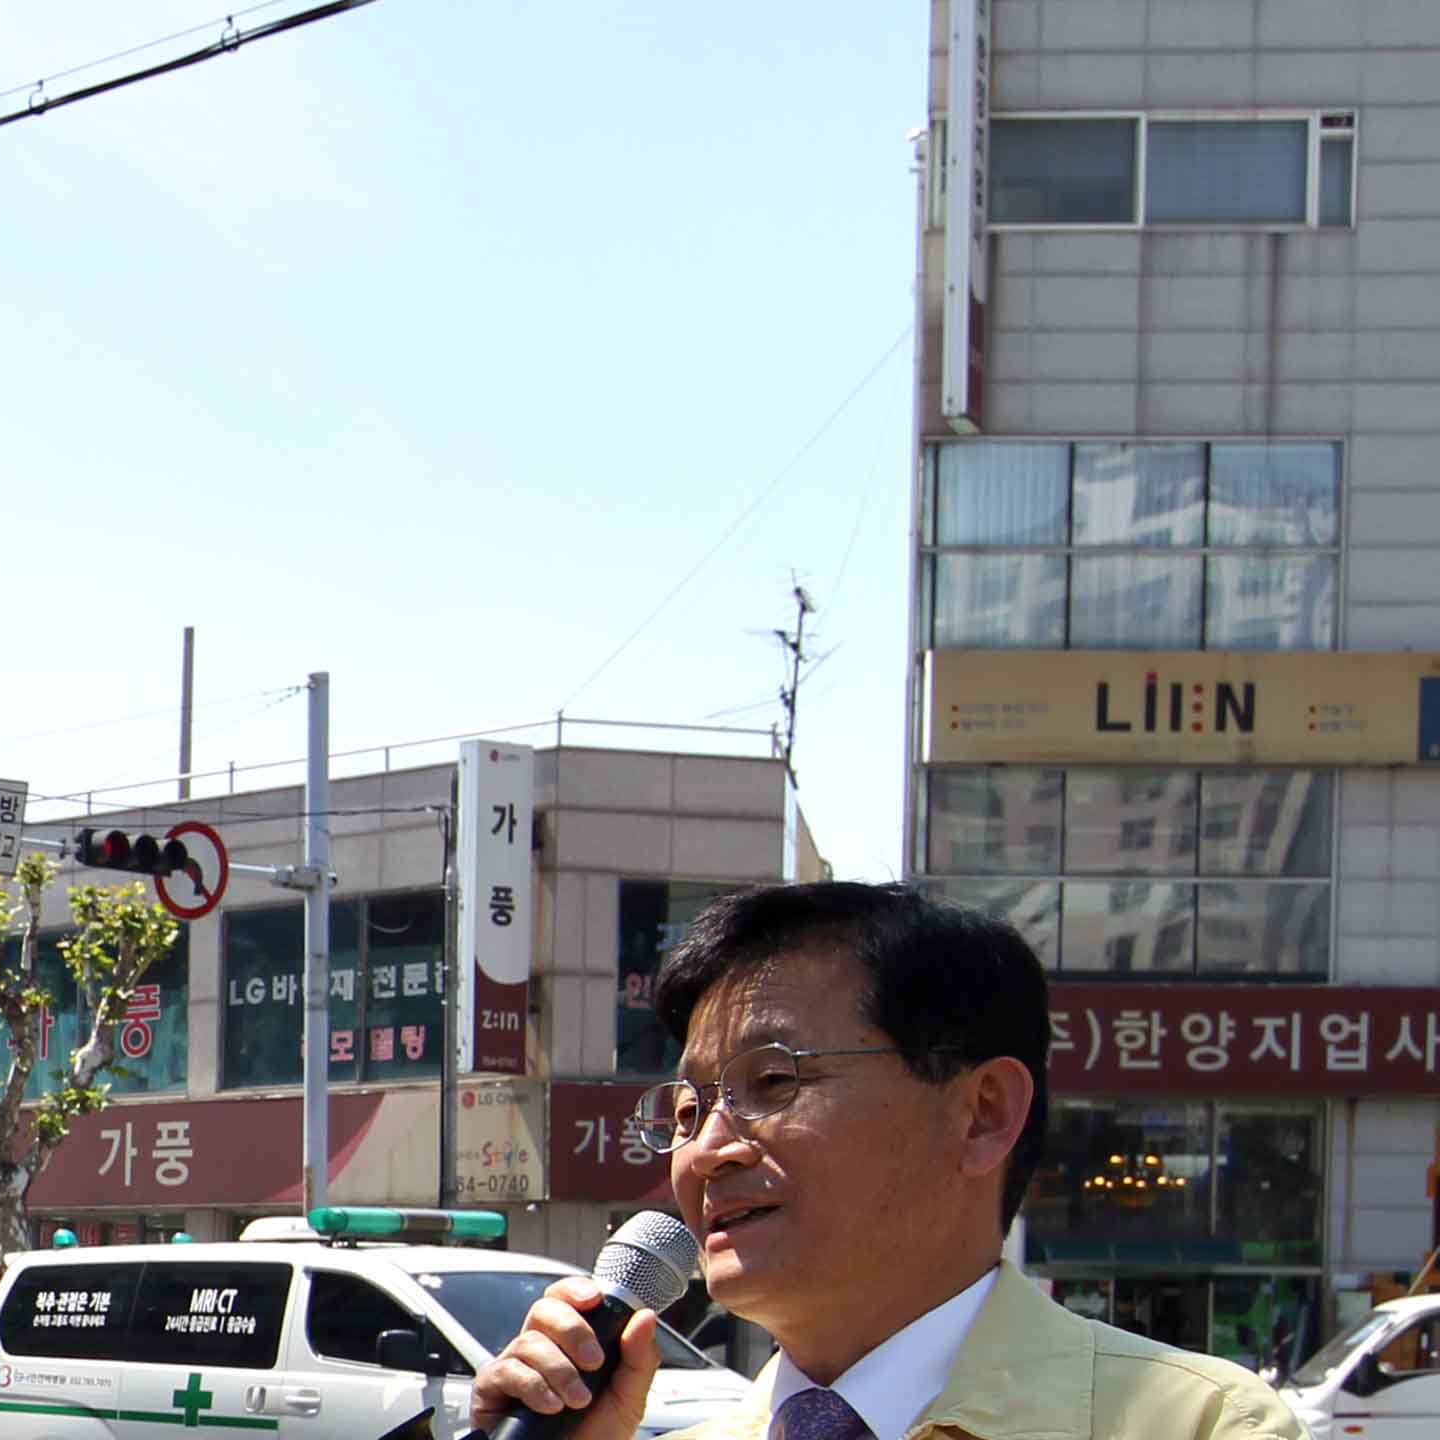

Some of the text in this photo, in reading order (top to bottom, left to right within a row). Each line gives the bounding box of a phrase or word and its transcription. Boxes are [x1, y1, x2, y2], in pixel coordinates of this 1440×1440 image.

[489, 803, 517, 927] 가풍
[230, 977, 265, 1006] LG
[272, 967, 355, 1006] 바재
[300, 1024, 426, 1063] 모델링
[98, 1121, 193, 1187] 가풍
